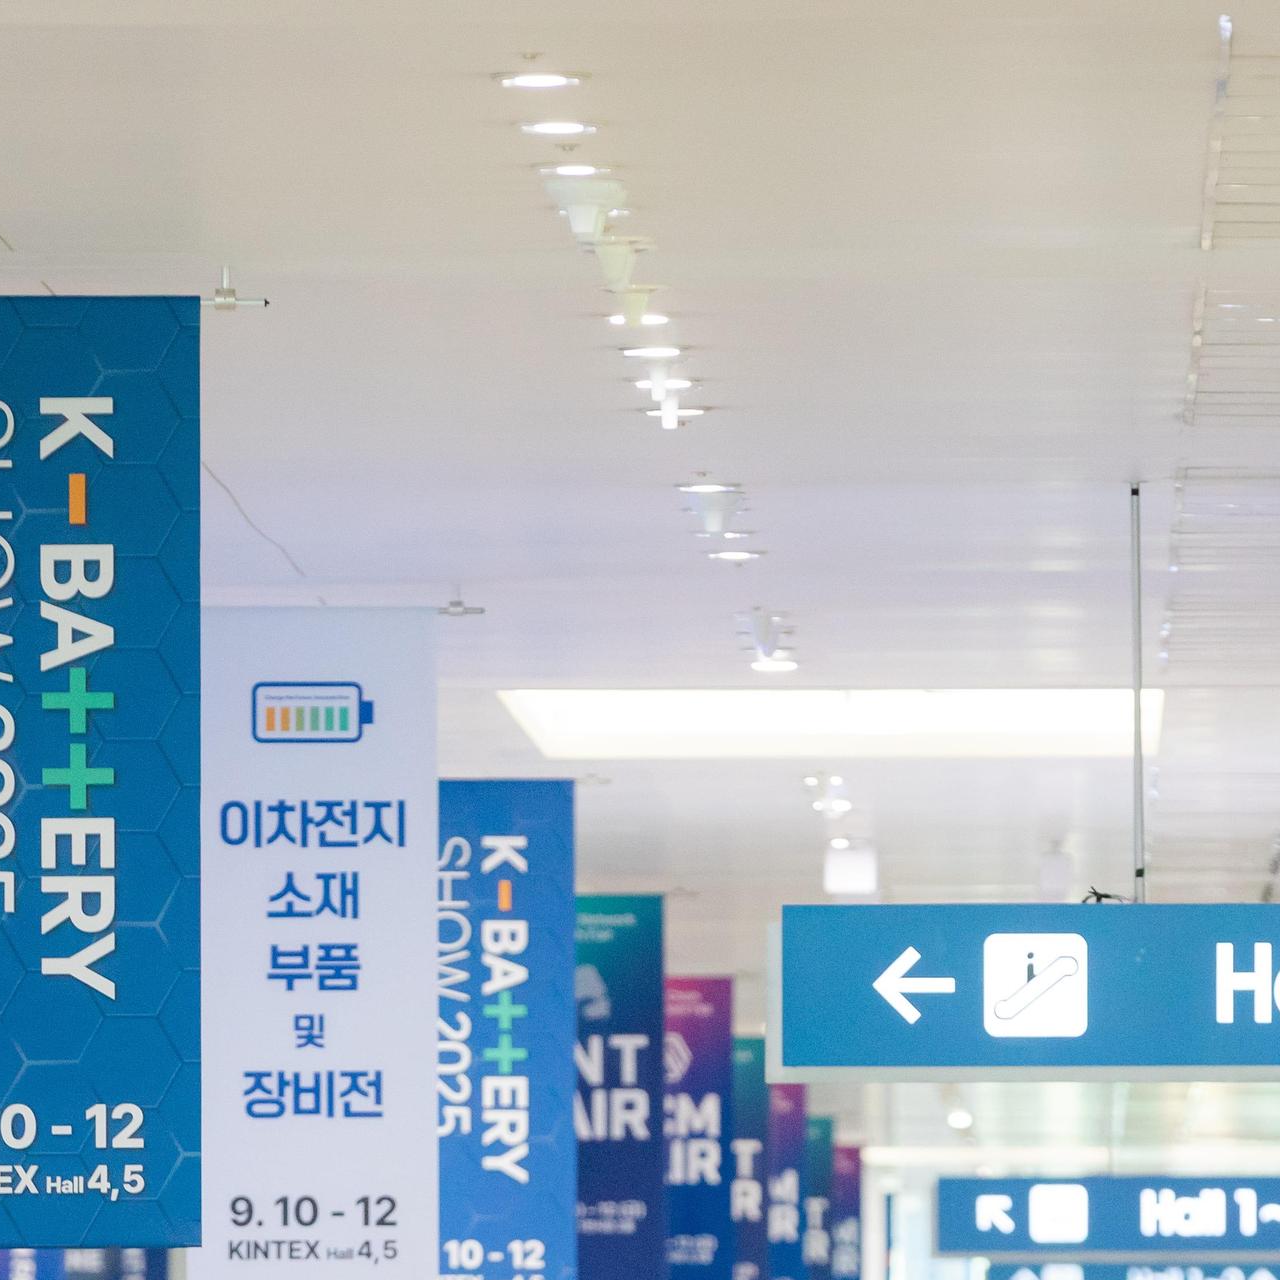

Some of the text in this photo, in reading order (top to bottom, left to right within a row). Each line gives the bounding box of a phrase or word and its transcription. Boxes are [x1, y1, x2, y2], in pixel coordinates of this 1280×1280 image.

[221, 799, 407, 848] 이차전지
[266, 871, 360, 920] 소재
[266, 944, 361, 992] 부품
[294, 1014, 325, 1049] 및
[242, 1070, 383, 1120] 장비전
[45, 1174, 84, 1195] Hall
[1140, 1187, 1227, 1238] Hall
[228, 1239, 320, 1260] KINTEX
[326, 1247, 354, 1260] Hall
